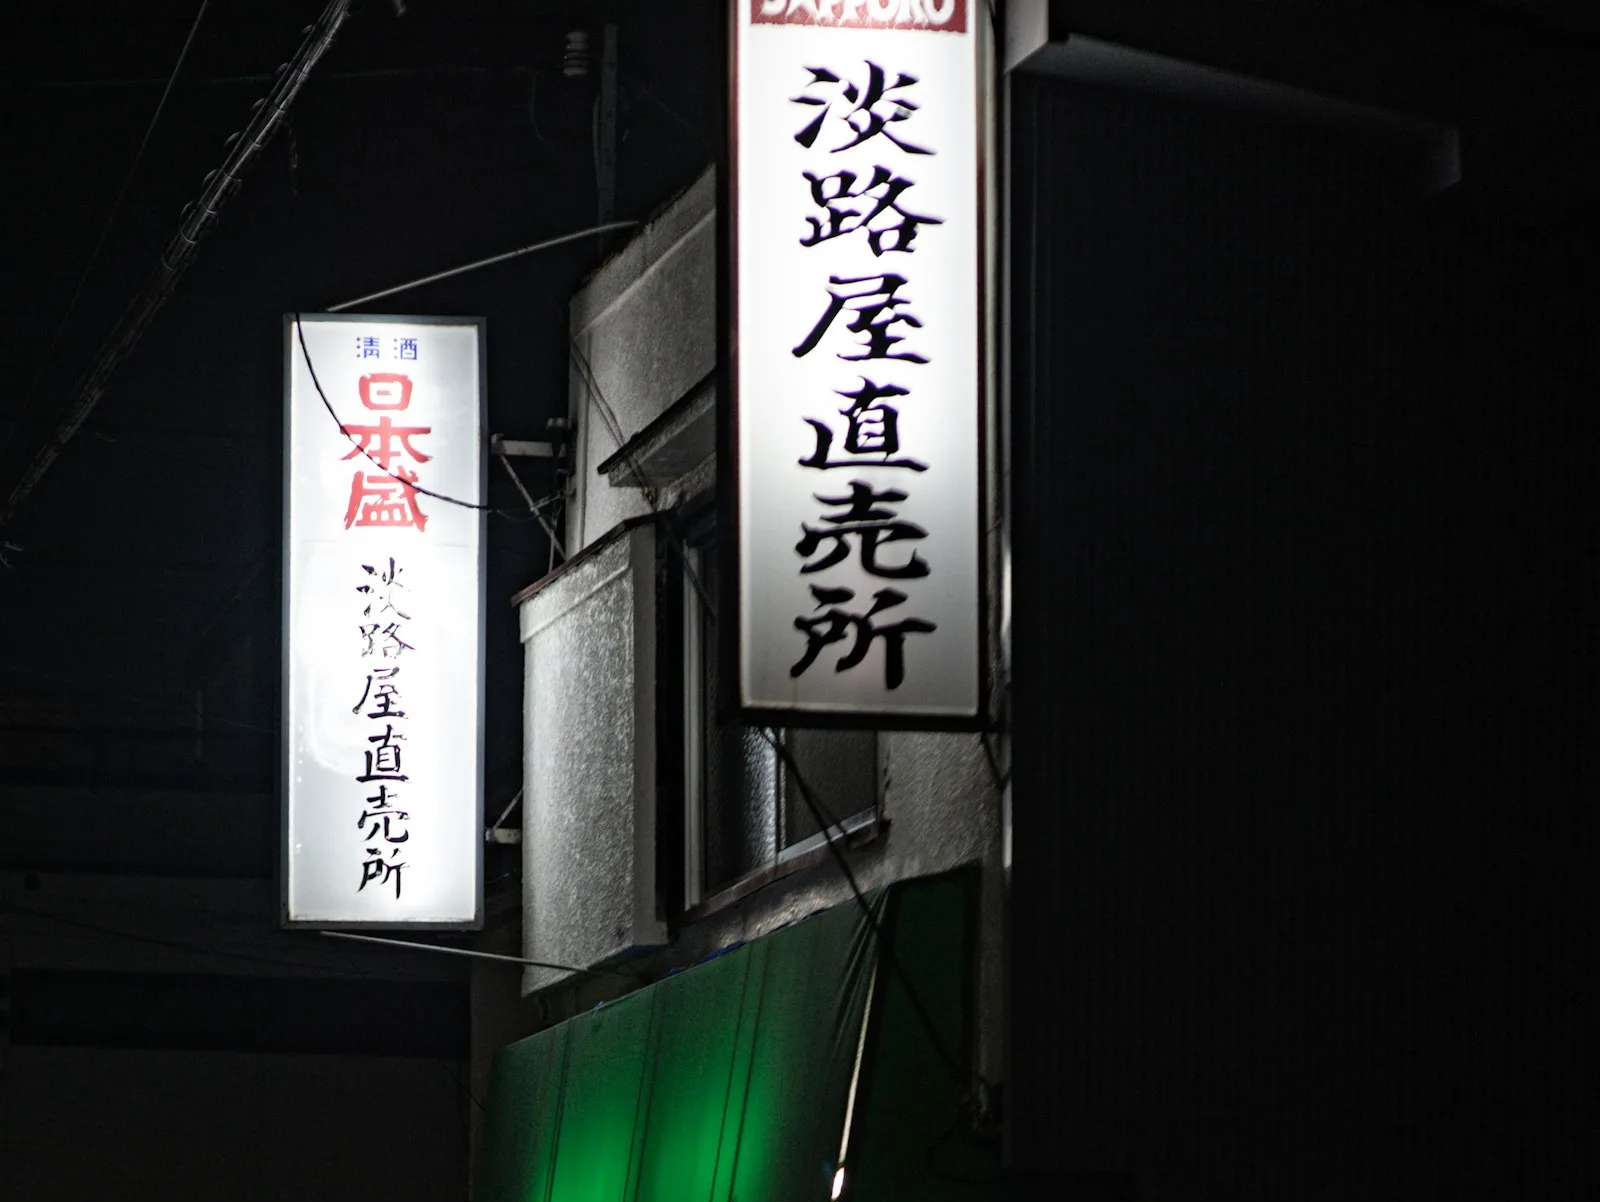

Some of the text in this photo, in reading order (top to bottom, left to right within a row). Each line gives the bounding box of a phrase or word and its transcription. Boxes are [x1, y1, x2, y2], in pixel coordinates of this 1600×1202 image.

[338, 372, 434, 533] 日本盛
[355, 336, 419, 361] 清酒
[788, 59, 948, 691] 淡路屋直売所
[351, 556, 416, 900] 淡路屋直売所
